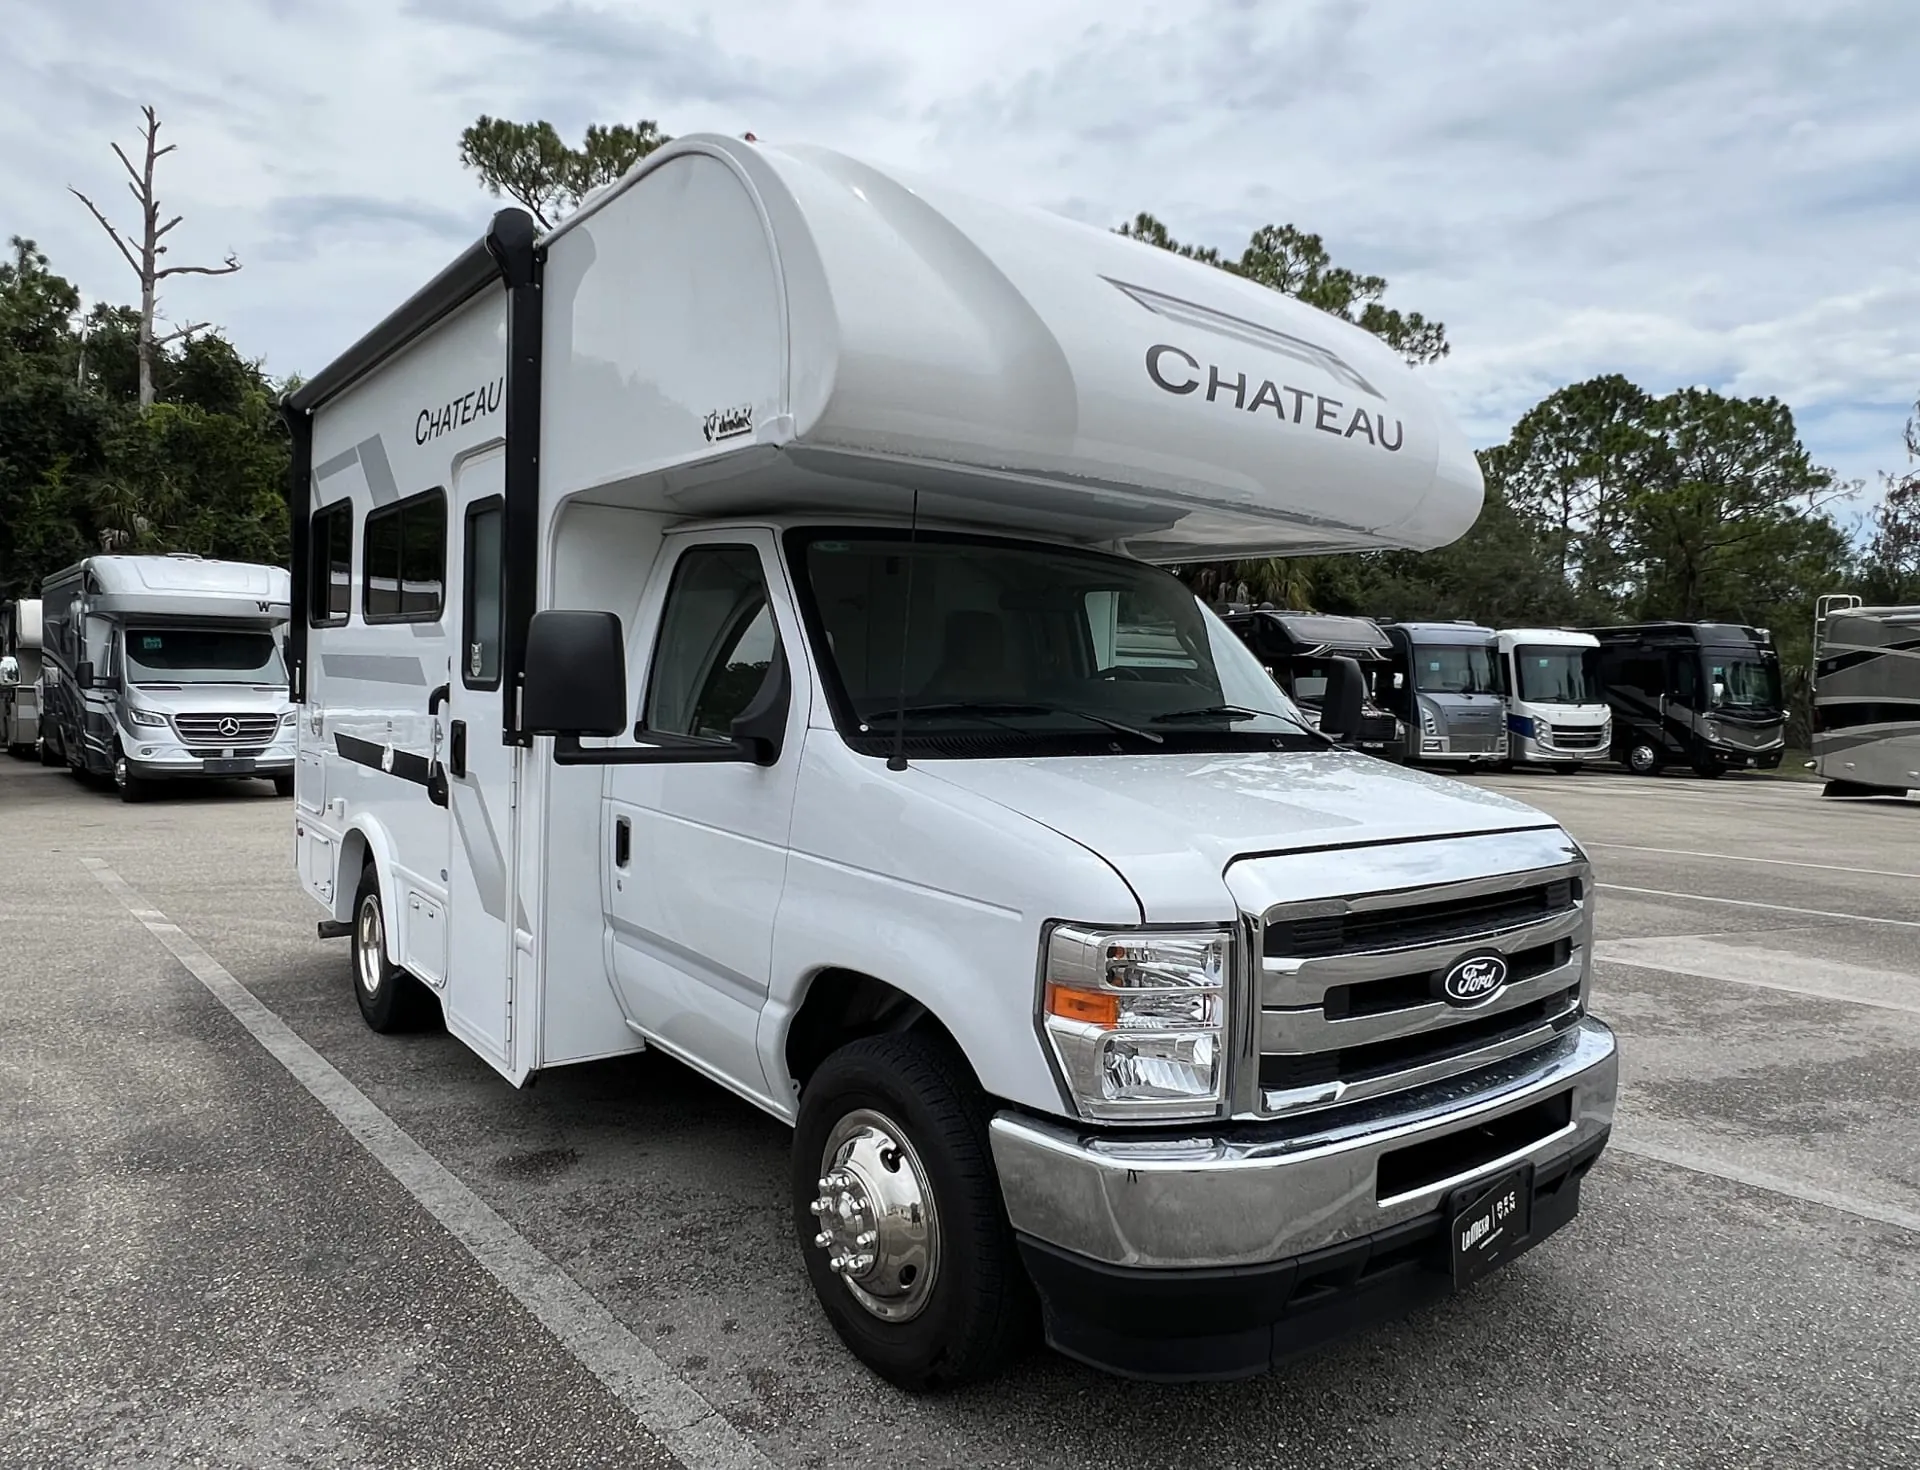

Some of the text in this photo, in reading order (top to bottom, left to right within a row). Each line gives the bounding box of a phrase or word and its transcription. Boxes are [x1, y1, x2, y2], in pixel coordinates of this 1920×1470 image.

[415, 376, 503, 446] CHATEAU
[1145, 344, 1404, 451] CHATEAU
[1457, 962, 1497, 995] Ford
